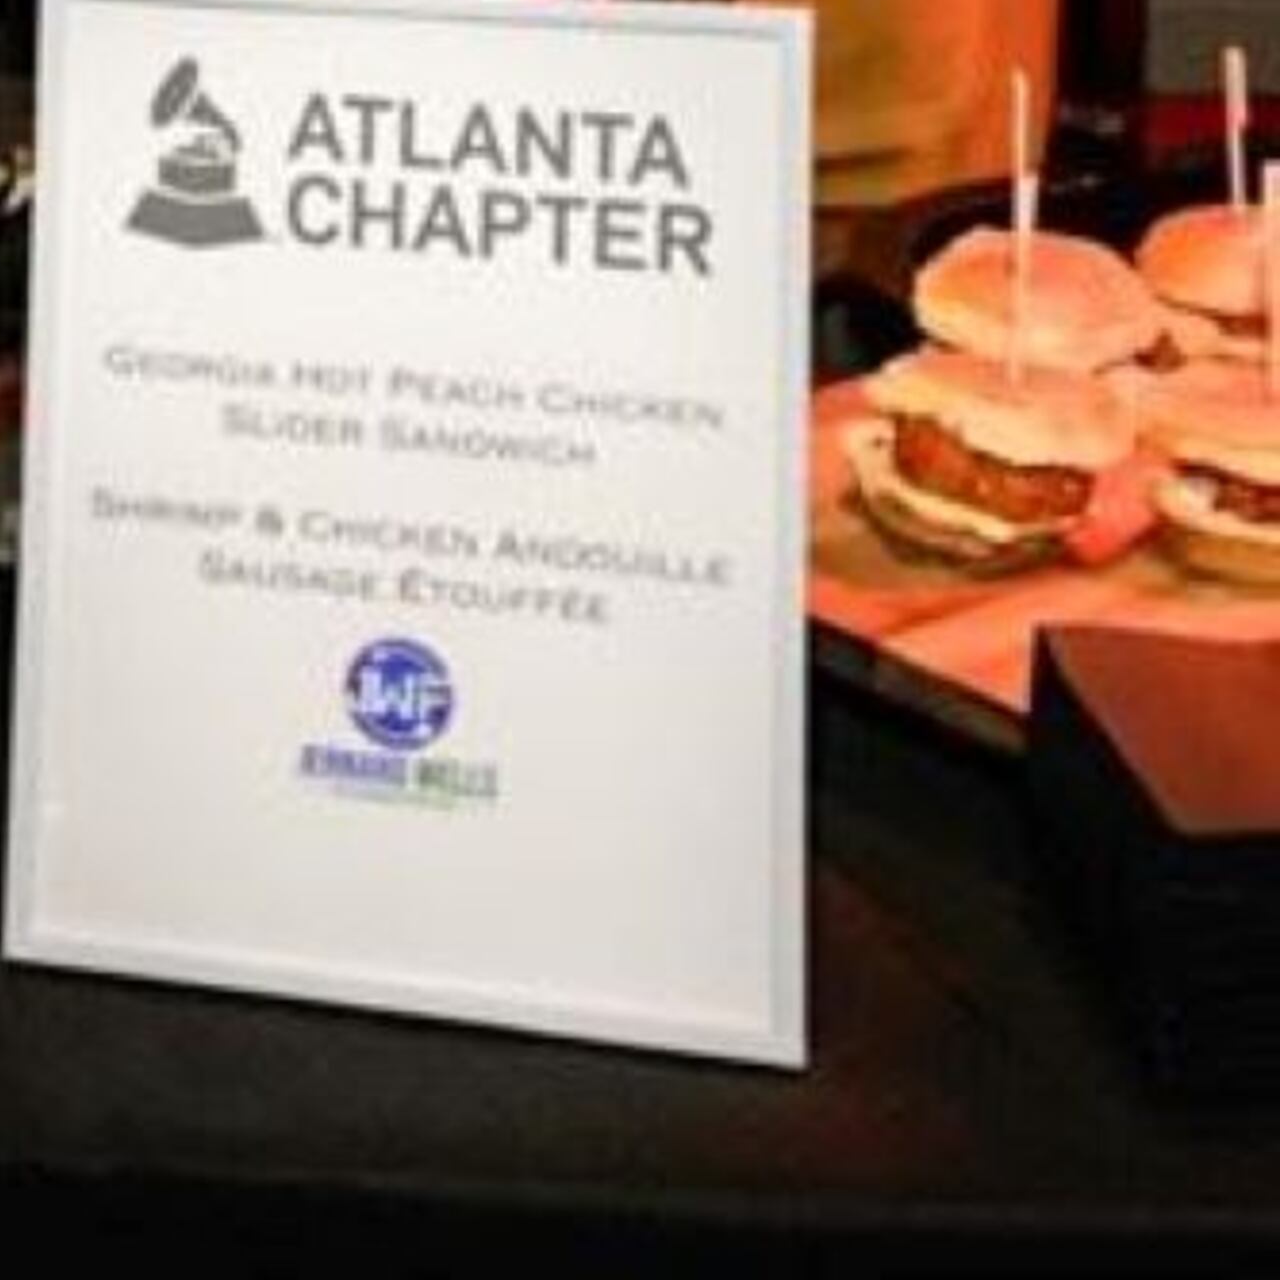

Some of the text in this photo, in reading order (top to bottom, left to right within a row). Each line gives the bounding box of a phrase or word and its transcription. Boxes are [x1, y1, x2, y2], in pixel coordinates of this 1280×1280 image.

[287, 92, 689, 188] ATLANTA
[286, 176, 715, 276] CHAPTER
[293, 360, 371, 394] HOT
[389, 366, 525, 411] PEACH
[538, 384, 724, 430] CHICKEN
[222, 403, 596, 466] SLIDER SANDWICH
[254, 505, 284, 534] &
[298, 510, 478, 558] CHICKEN
